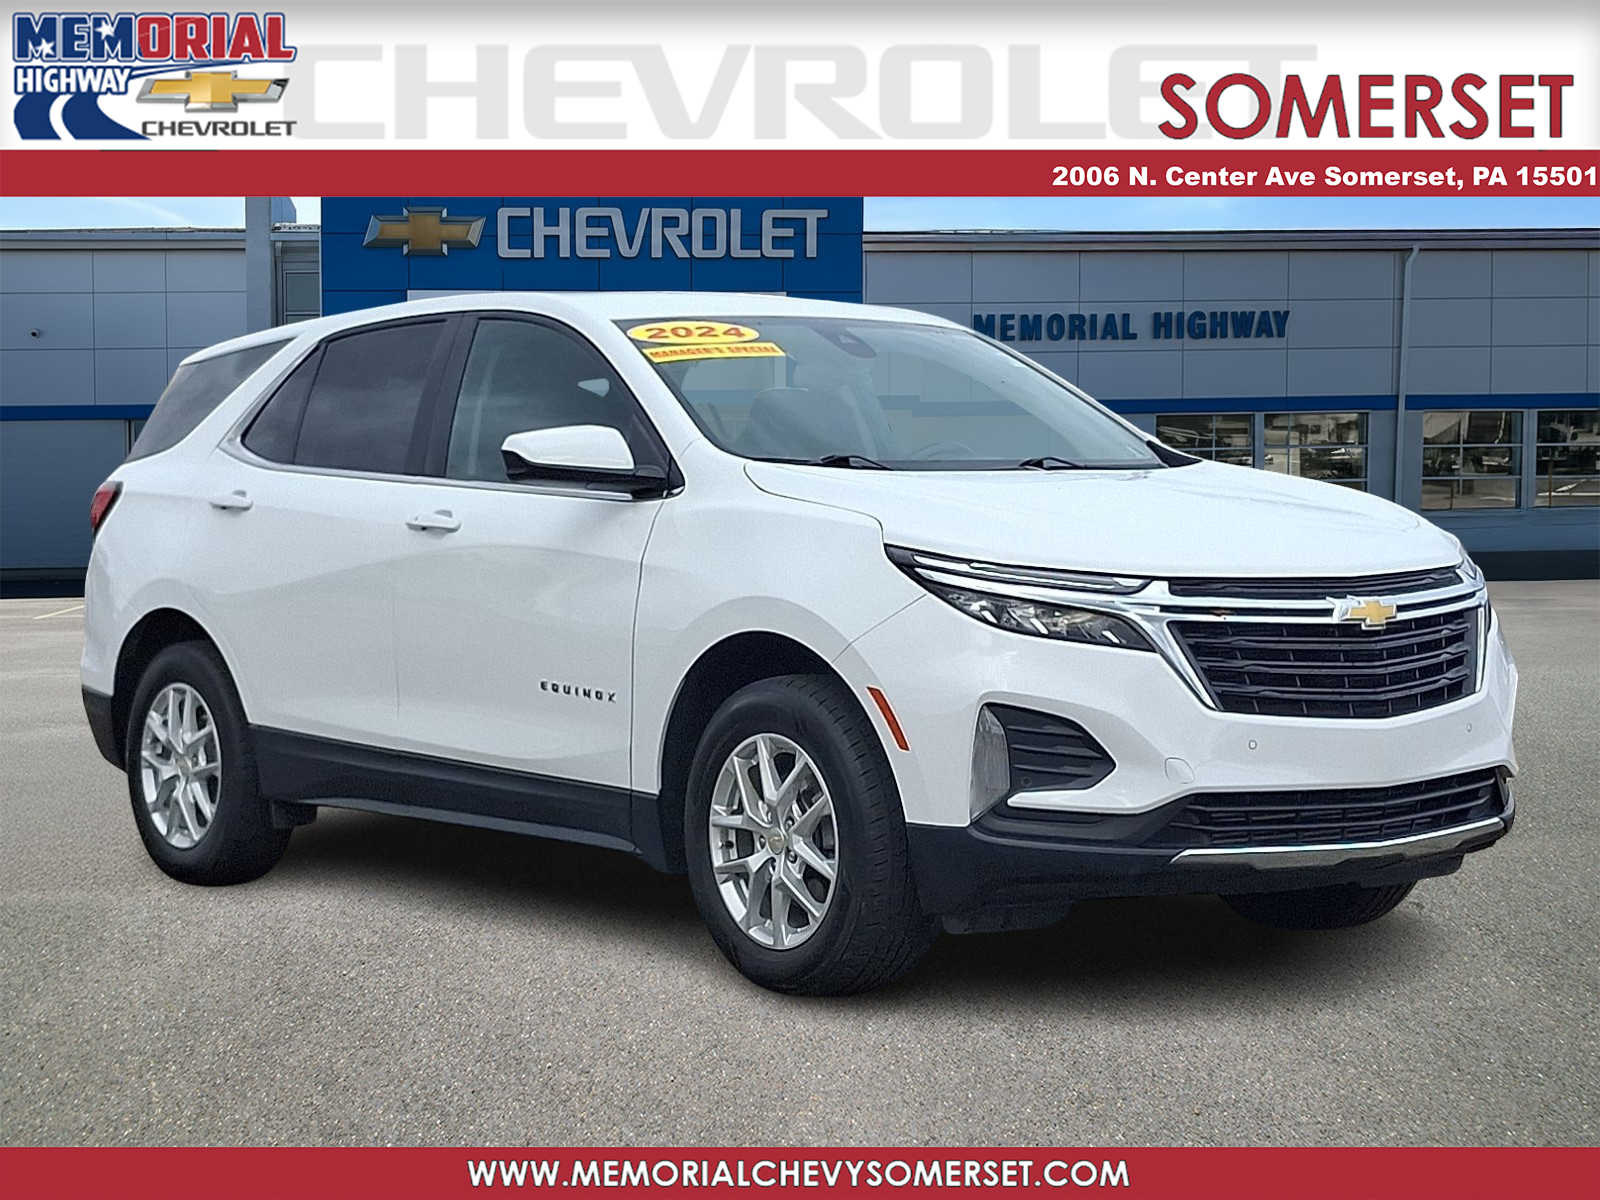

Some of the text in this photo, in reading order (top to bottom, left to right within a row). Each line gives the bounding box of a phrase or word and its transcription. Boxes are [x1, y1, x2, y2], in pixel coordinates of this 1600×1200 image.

[497, 207, 829, 258] CHEVROLET
[645, 326, 745, 339] 2024
[973, 310, 1291, 341] MEMORIAL HIGHWAY
[727, 345, 779, 353] SPECIAL
[540, 681, 616, 703] EQUINOX
